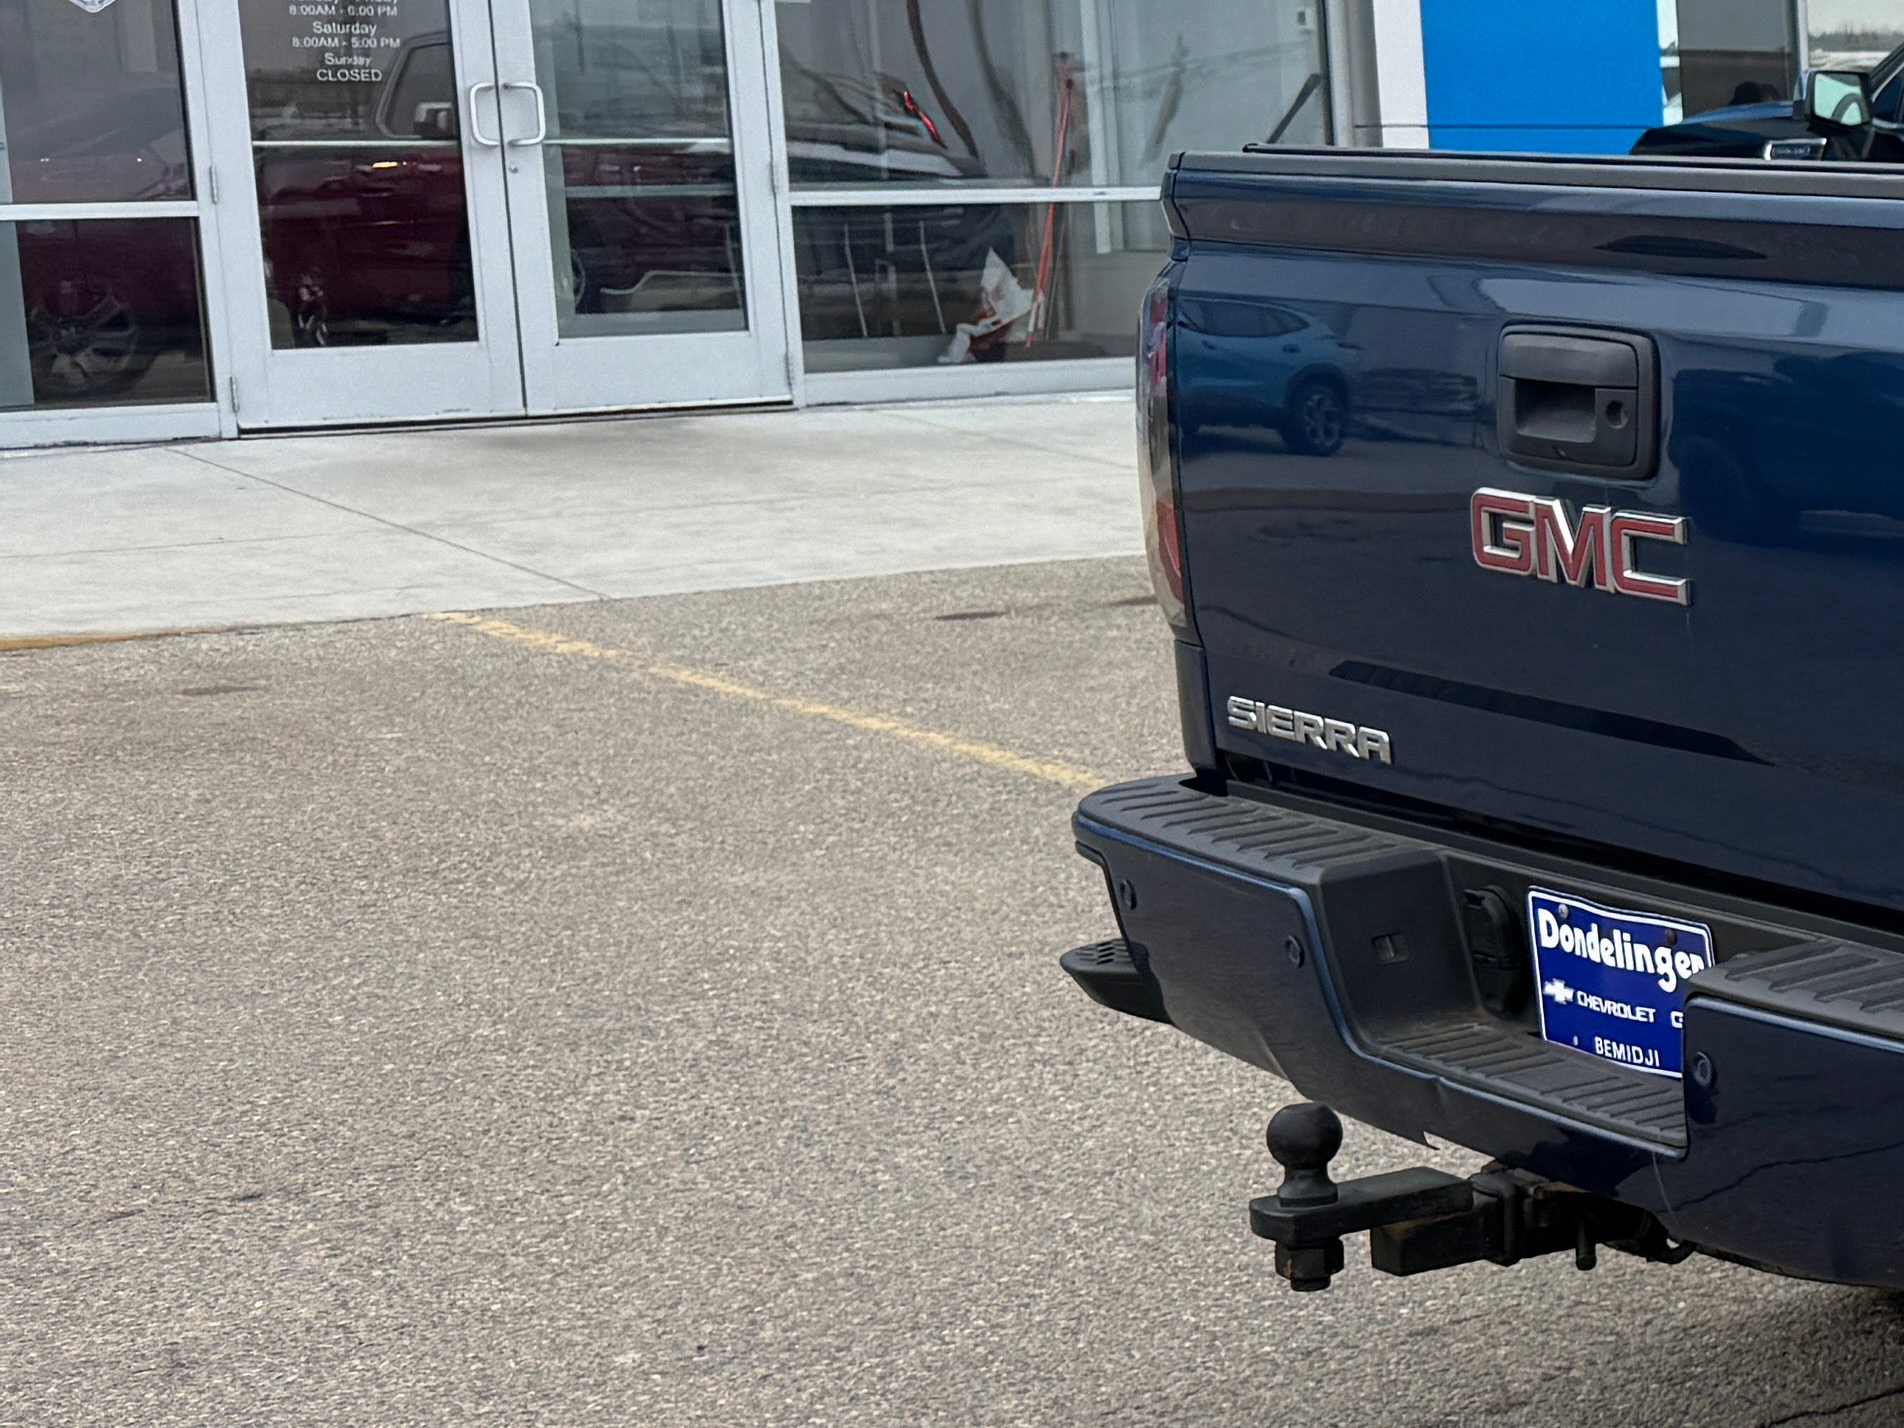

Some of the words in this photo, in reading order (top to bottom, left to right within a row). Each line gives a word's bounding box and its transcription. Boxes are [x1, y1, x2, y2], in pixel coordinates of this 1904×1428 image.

[377, 6, 398, 16] PM
[312, 21, 377, 36] Saturday
[381, 38, 400, 48] PM
[324, 52, 371, 67] Sunday
[316, 69, 382, 82] CLOSED
[1470, 487, 1692, 606] GMC
[1227, 696, 1391, 764] SIERRA
[1537, 908, 1705, 993] Dondelinger
[1576, 990, 1656, 1023] CHEVROLET
[1594, 1036, 1660, 1067] BEMIDJI
